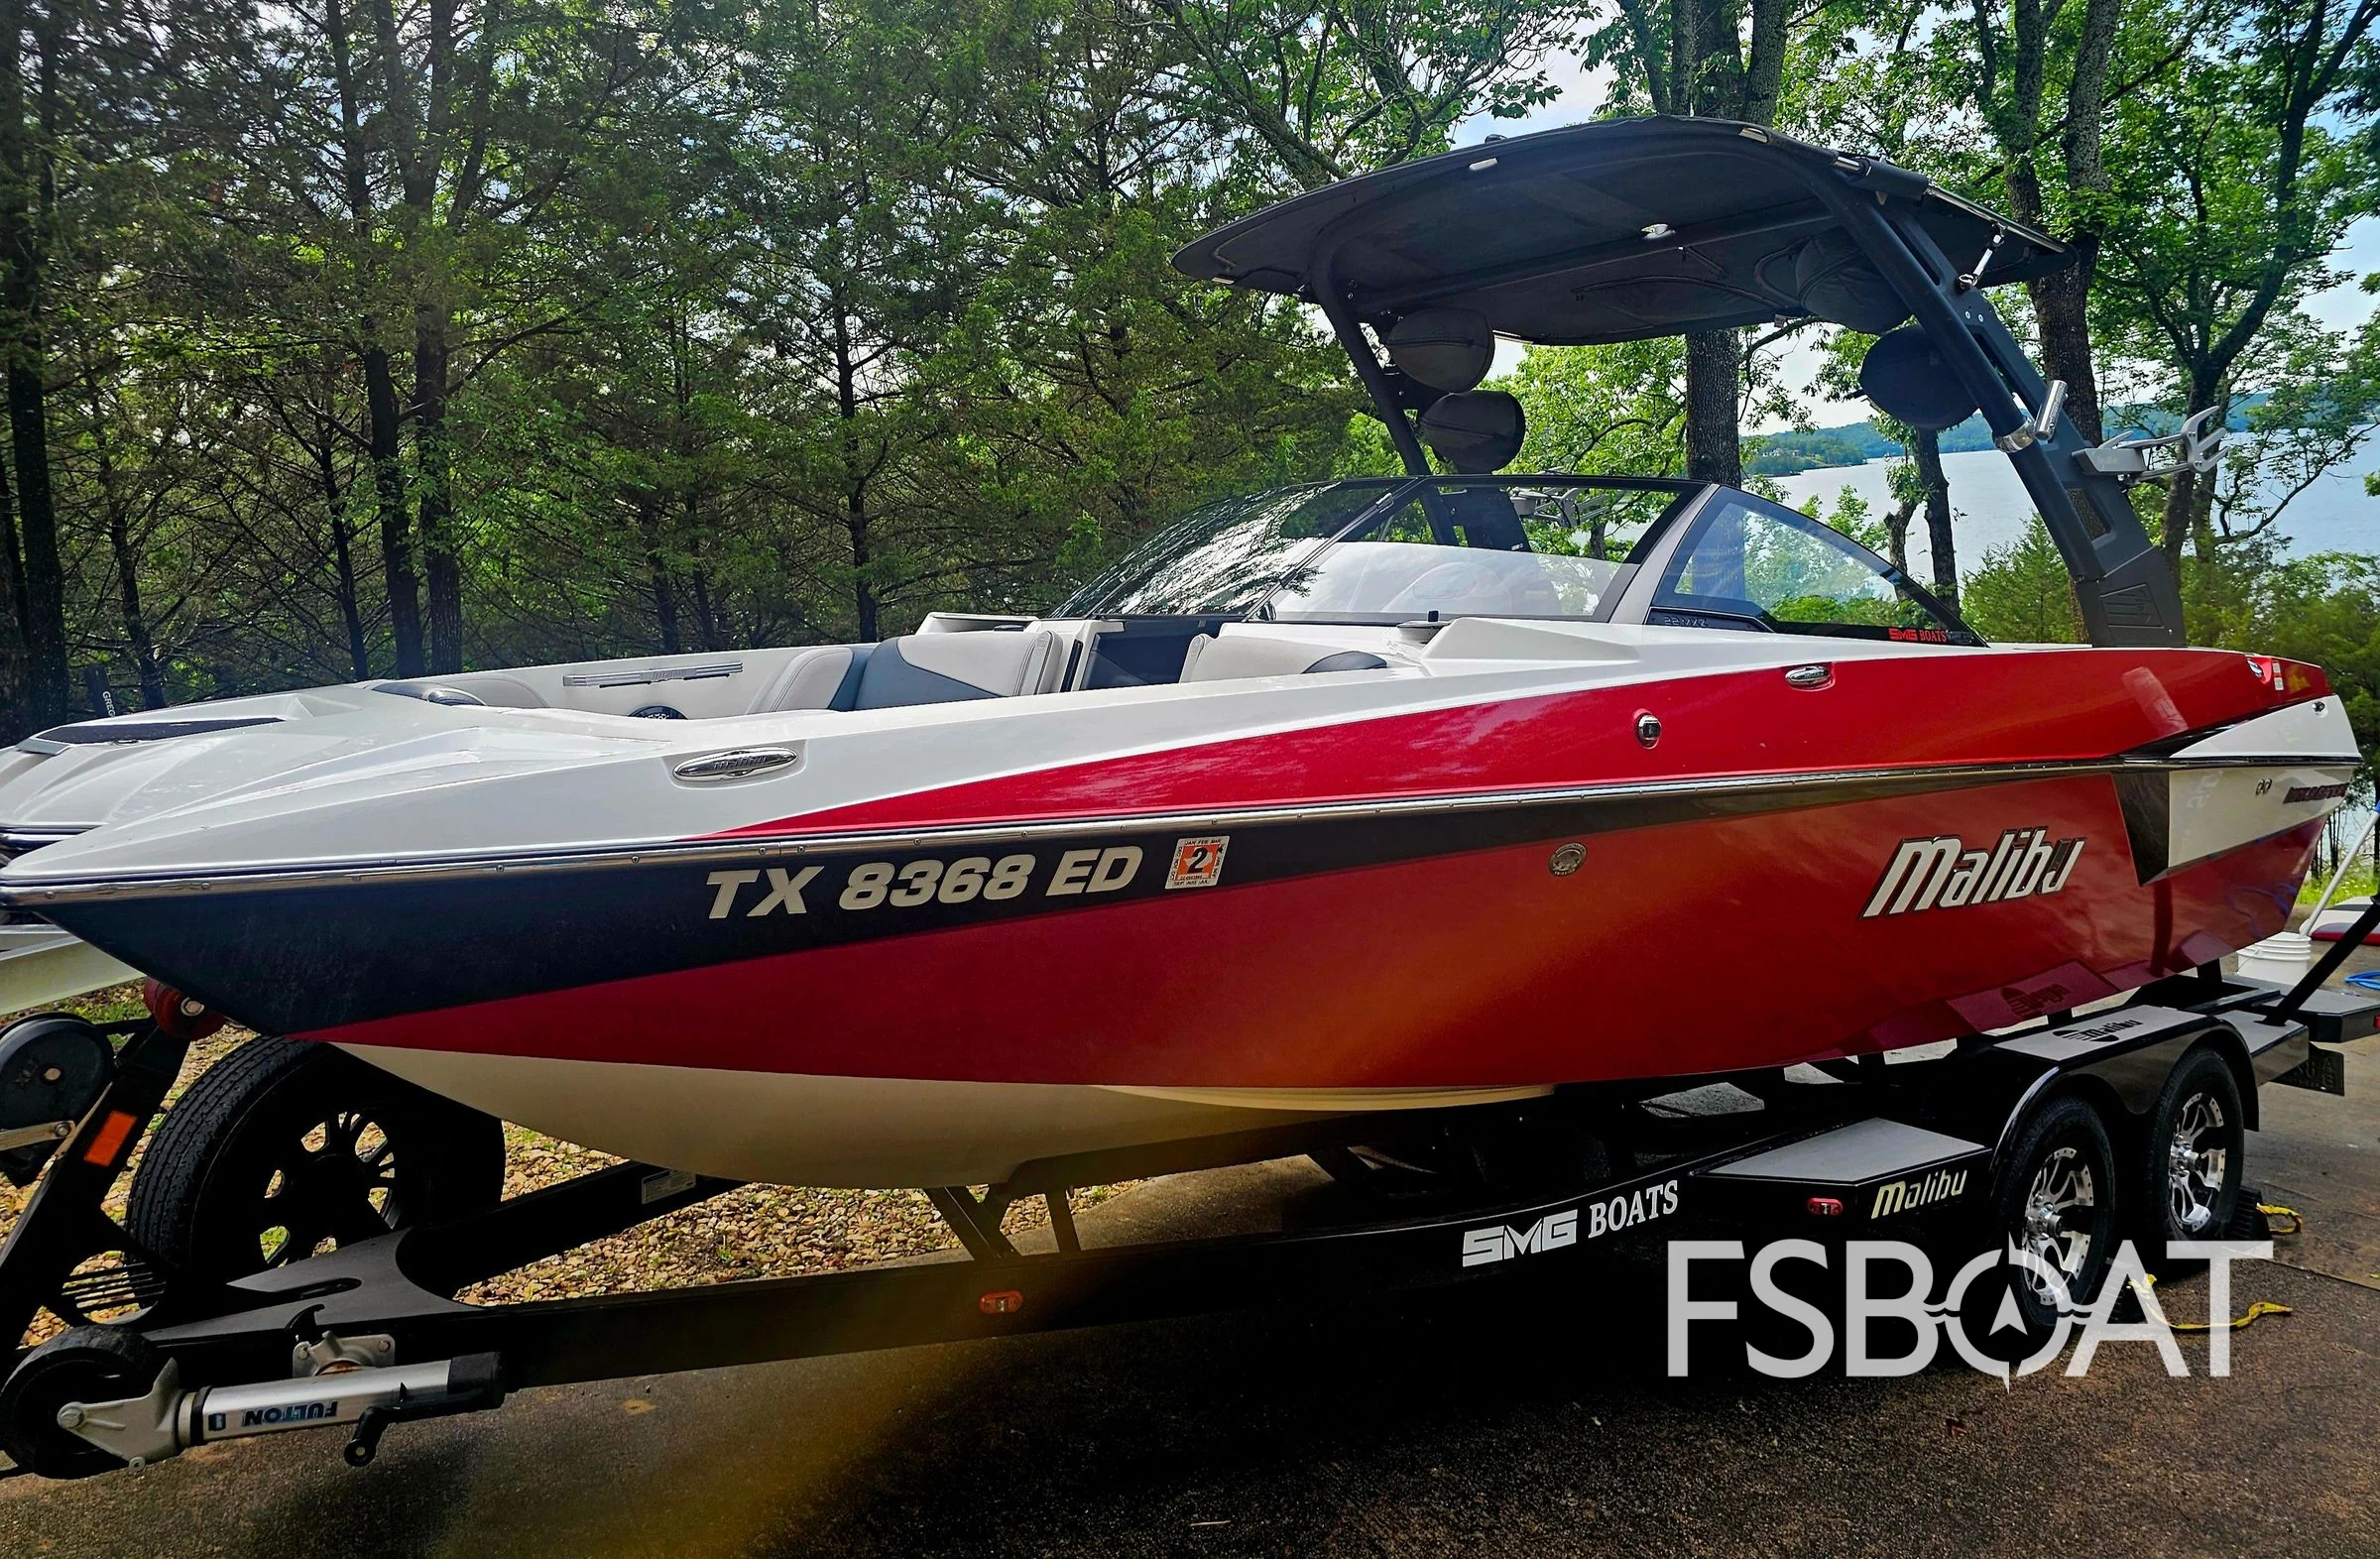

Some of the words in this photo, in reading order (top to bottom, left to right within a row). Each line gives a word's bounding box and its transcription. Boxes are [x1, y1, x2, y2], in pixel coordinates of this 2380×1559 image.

[1888, 628, 1918, 641] SMG
[1919, 629, 1948, 643] BOATS
[1187, 847, 1209, 874] 2
[706, 866, 824, 919] TX
[838, 854, 1036, 910] 8368
[1045, 845, 1143, 897] ED
[1462, 1208, 1579, 1267] SMG
[1588, 1179, 1679, 1239] BOATS
[244, 1400, 338, 1427] FULTON
